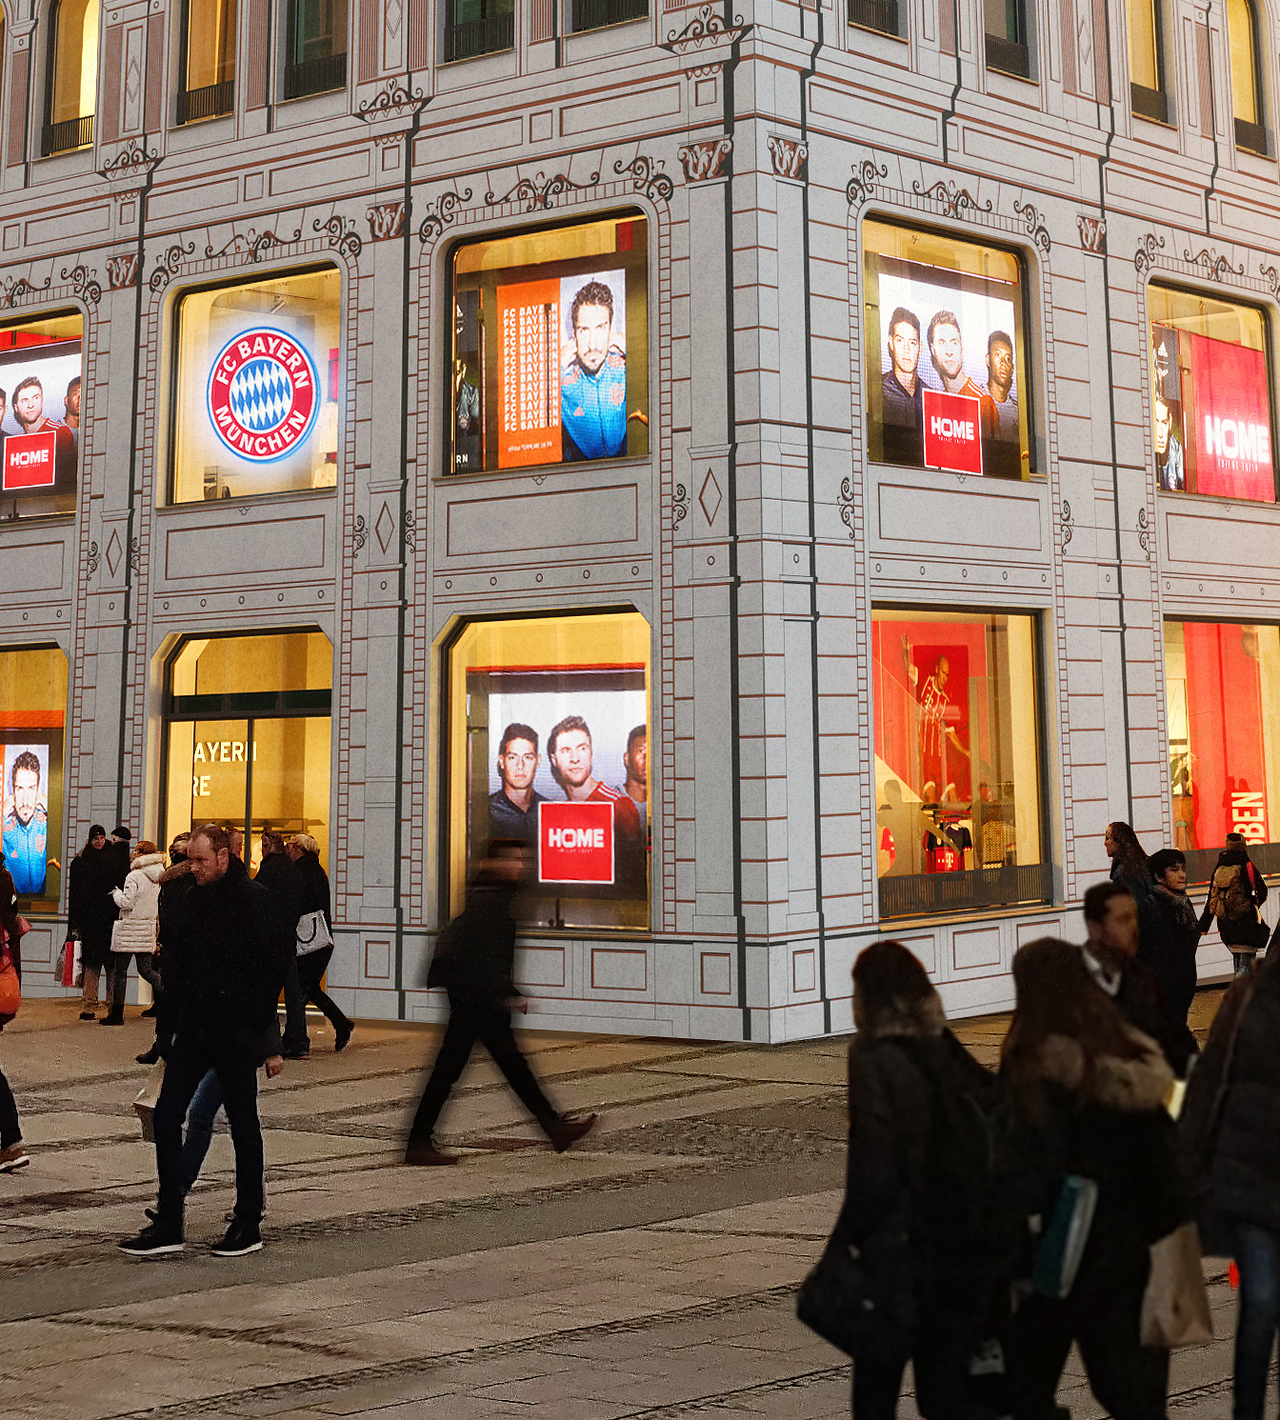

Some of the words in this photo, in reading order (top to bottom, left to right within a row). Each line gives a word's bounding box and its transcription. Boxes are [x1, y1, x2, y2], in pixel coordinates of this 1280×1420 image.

[215, 355, 237, 386] FC
[237, 336, 310, 390] BAYERN
[215, 405, 306, 454] MÜNCHEN
[931, 416, 975, 440] HOME
[1205, 415, 1270, 464] HOME
[10, 449, 49, 466] HOME
[193, 741, 257, 763] AYERN
[192, 775, 211, 797] RE
[1231, 792, 1266, 846] BEN
[548, 828, 604, 848] HOME
